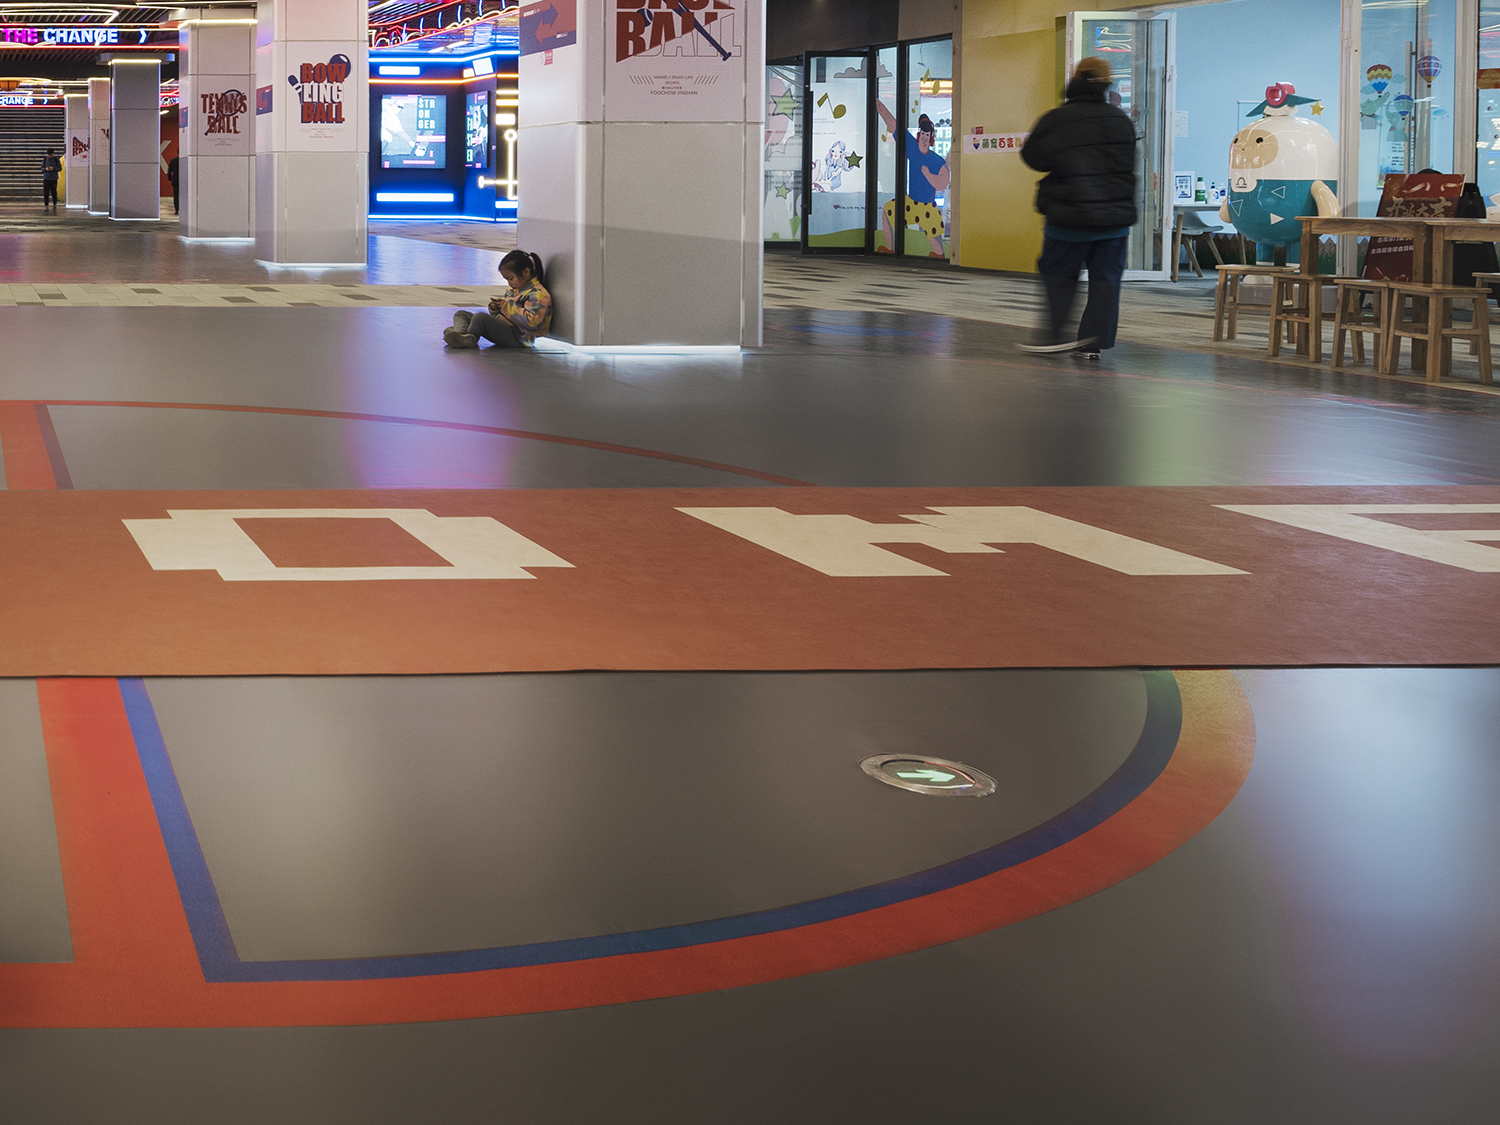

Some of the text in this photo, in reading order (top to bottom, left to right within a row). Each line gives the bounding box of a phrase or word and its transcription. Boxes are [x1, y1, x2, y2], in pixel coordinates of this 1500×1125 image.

[2, 28, 38, 43] THE
[43, 28, 118, 44] CHANGE
[616, 11, 741, 63] BALL
[300, 62, 347, 83] BOW
[302, 82, 344, 103] LING
[418, 99, 435, 109] STR
[301, 102, 345, 123] BALL
[418, 109, 430, 119] ON
[418, 120, 435, 129] GER
[982, 137, 1027, 149] 萌宠百变娱
